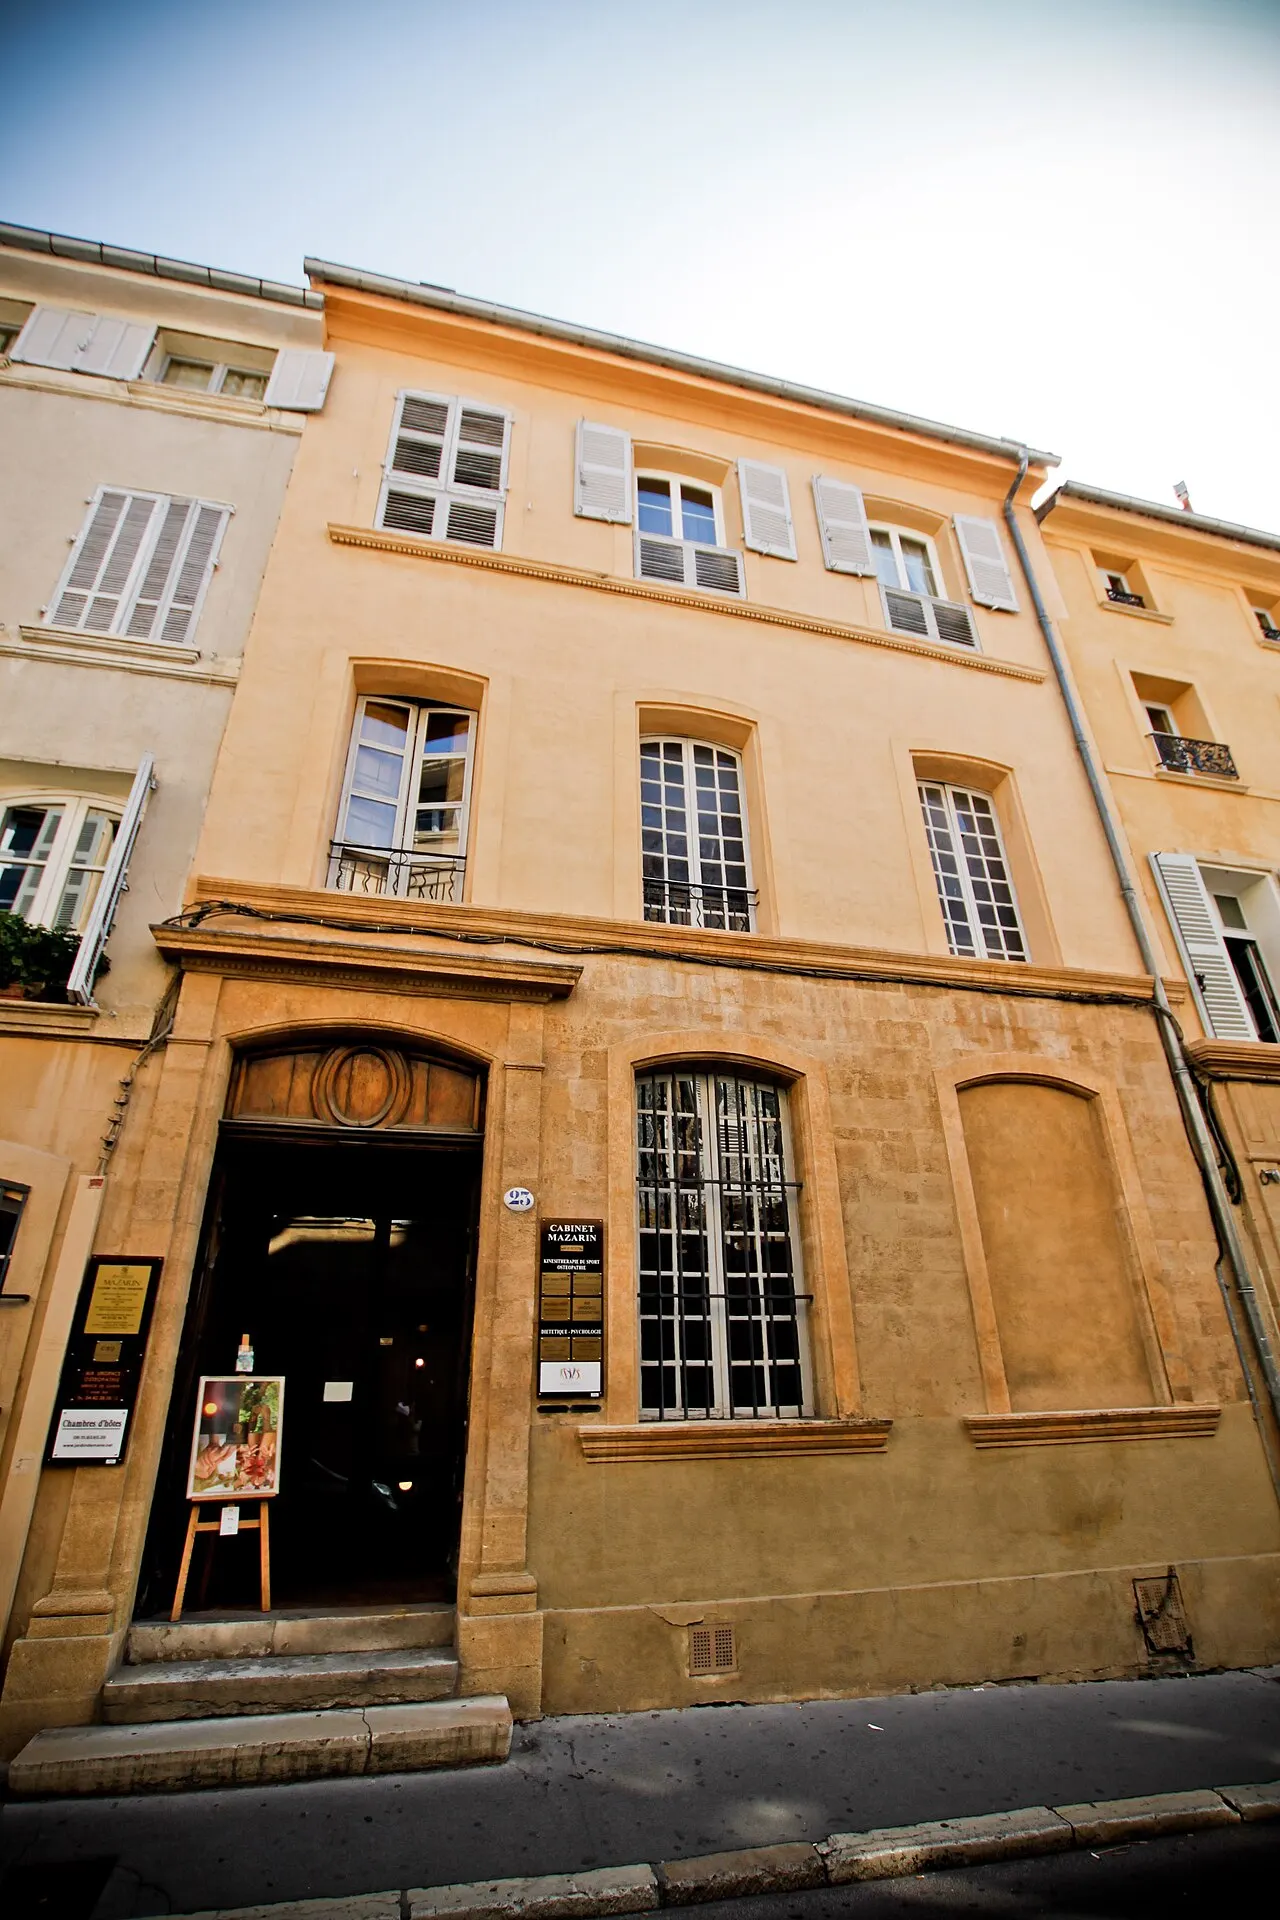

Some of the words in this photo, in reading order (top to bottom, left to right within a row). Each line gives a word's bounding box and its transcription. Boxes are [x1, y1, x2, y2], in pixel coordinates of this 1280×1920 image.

[549, 1224, 595, 1233] CABINET
[547, 1233, 597, 1242] MAZARIN
[62, 1419, 96, 1427] Chambres
[98, 1419, 122, 1427] d'hôtes
